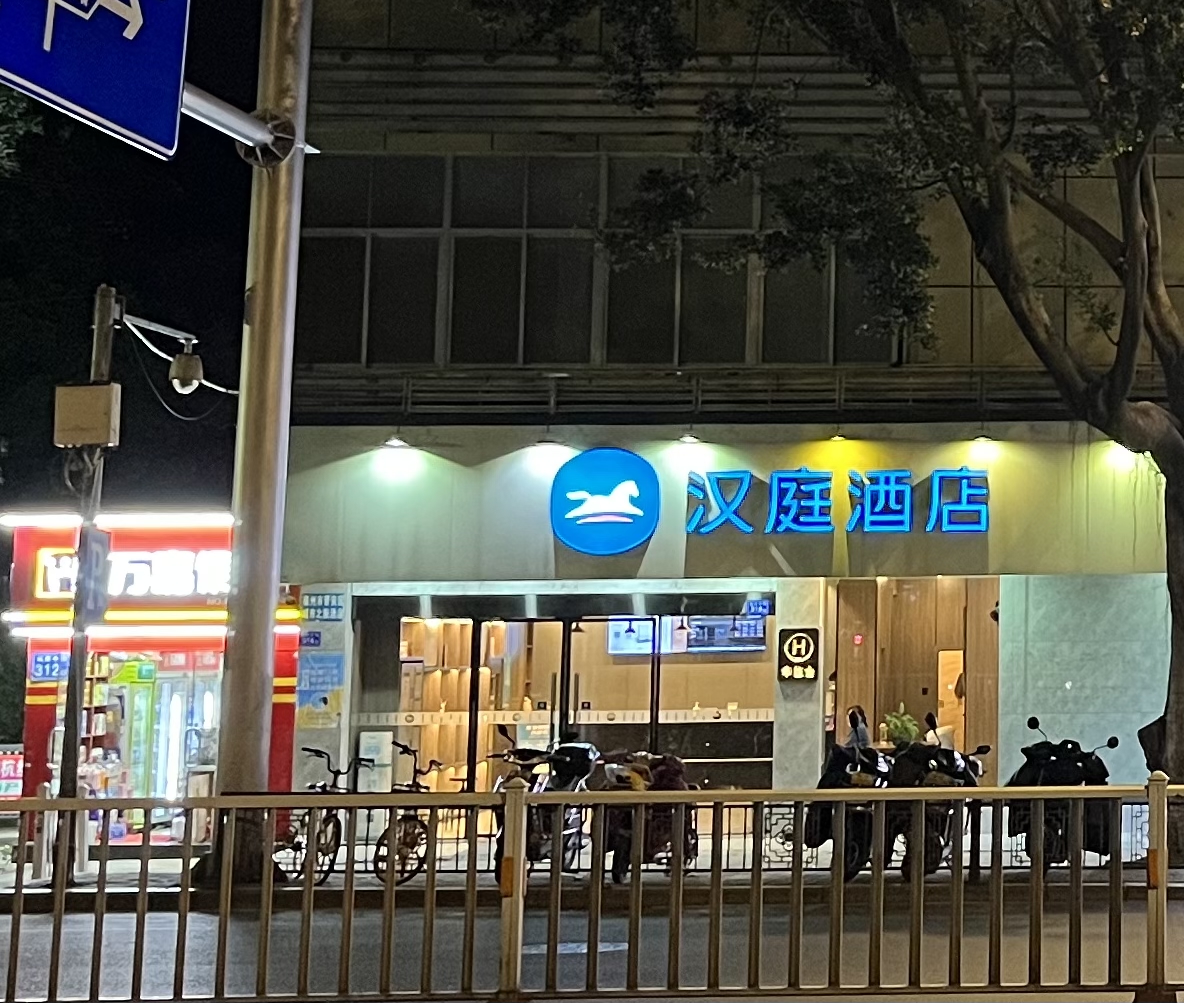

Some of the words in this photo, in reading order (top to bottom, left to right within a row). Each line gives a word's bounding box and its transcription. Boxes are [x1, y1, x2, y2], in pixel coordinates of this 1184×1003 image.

[686, 466, 989, 534] 汉庭酒店
[34, 662, 60, 677] 312
